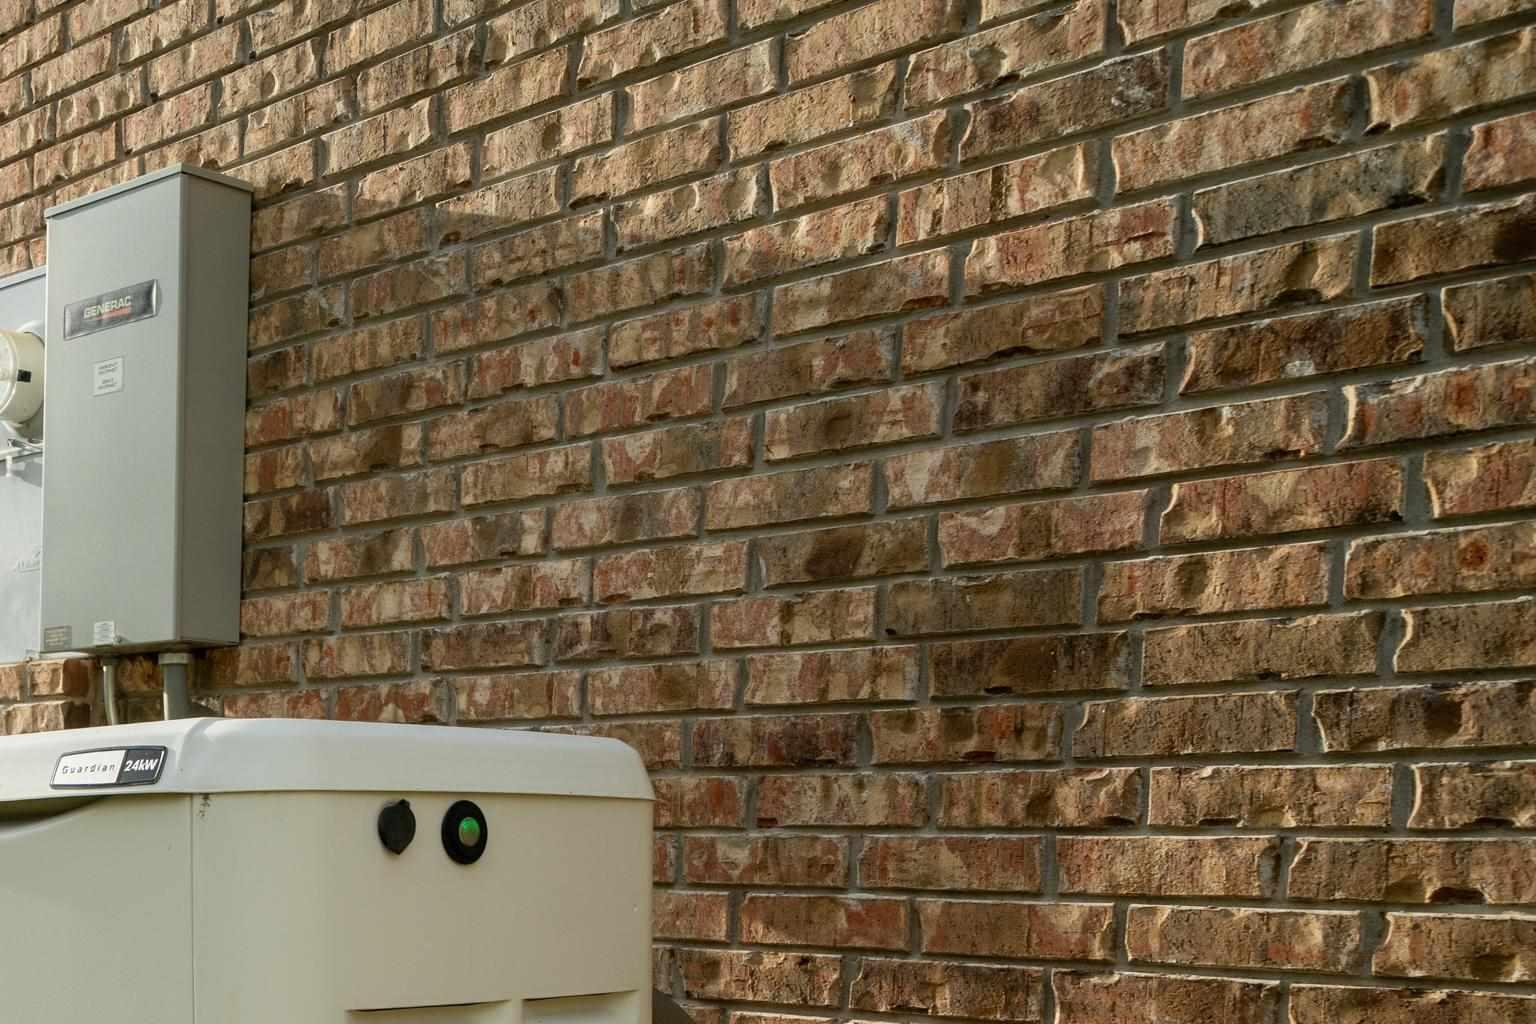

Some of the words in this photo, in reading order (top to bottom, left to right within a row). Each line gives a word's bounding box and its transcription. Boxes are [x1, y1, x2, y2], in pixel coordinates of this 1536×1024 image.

[83, 296, 132, 319] GENERAC
[62, 763, 115, 774] Guardian
[123, 758, 158, 772] 24kW
